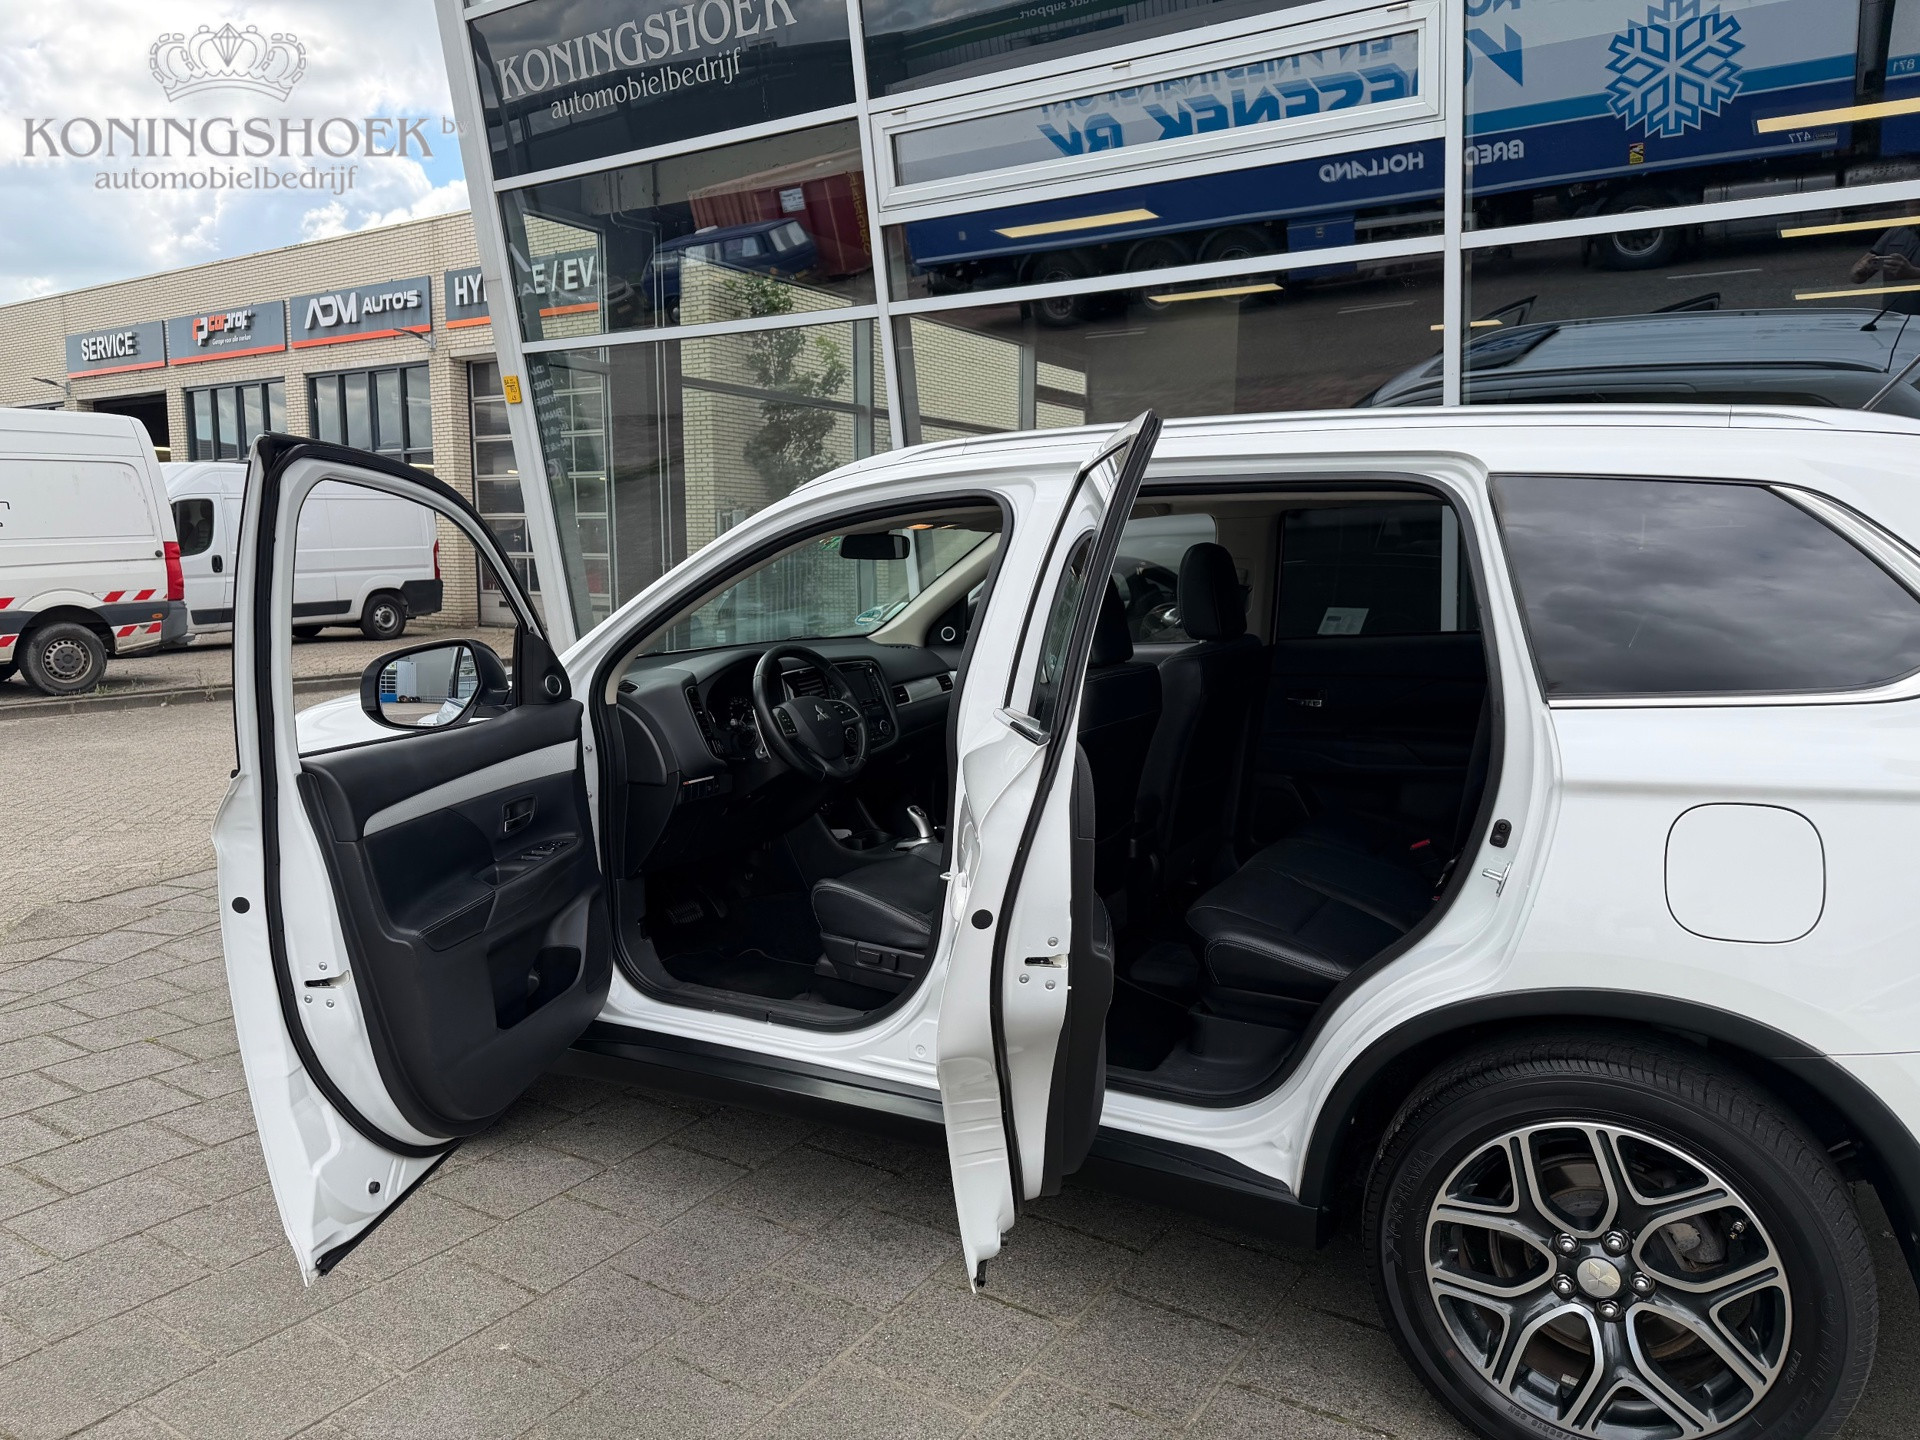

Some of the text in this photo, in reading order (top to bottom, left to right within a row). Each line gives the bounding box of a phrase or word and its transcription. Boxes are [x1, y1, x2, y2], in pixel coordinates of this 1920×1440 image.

[497, 0, 798, 101] KONINGSHOEK
[551, 47, 741, 120] automobielbedrijf
[362, 289, 418, 314] AUTO'S
[454, 273, 488, 306] HY
[563, 256, 595, 290] EV
[81, 331, 134, 361] SERVICE
[1386, 1149, 1434, 1239] YOKOHAMA
